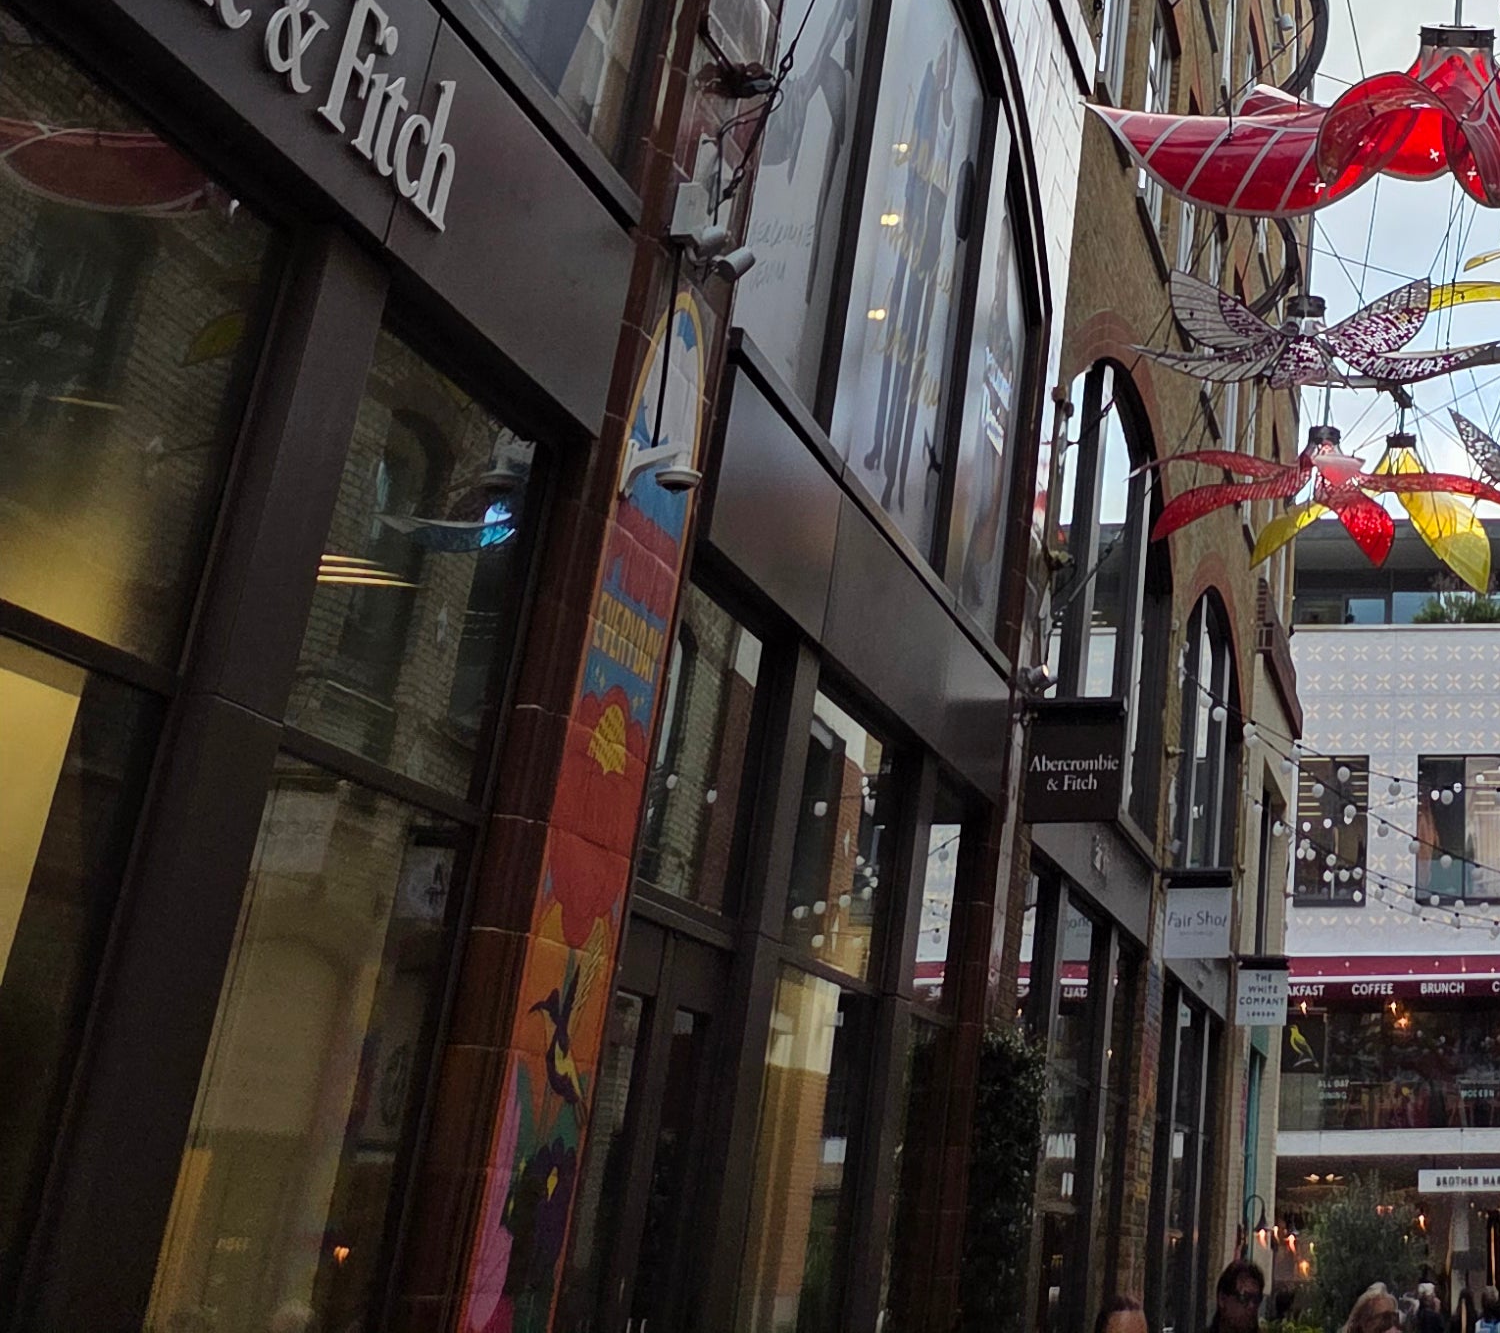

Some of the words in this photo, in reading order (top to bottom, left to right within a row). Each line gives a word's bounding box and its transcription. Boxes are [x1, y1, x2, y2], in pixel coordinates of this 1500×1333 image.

[1029, 754, 1119, 772] Abercrombie
[1047, 778, 1058, 791] &
[1063, 773, 1097, 790] Fitch
[1168, 911, 1192, 928] Fair
[1196, 910, 1227, 927] Shot
[1255, 973, 1272, 983] THE
[1248, 985, 1278, 994] WHITE
[1351, 983, 1394, 995] COFFEE
[1420, 982, 1465, 994] BRUNCH
[1239, 997, 1285, 1006] COMPANY
[1436, 1176, 1479, 1186] BROTHER
